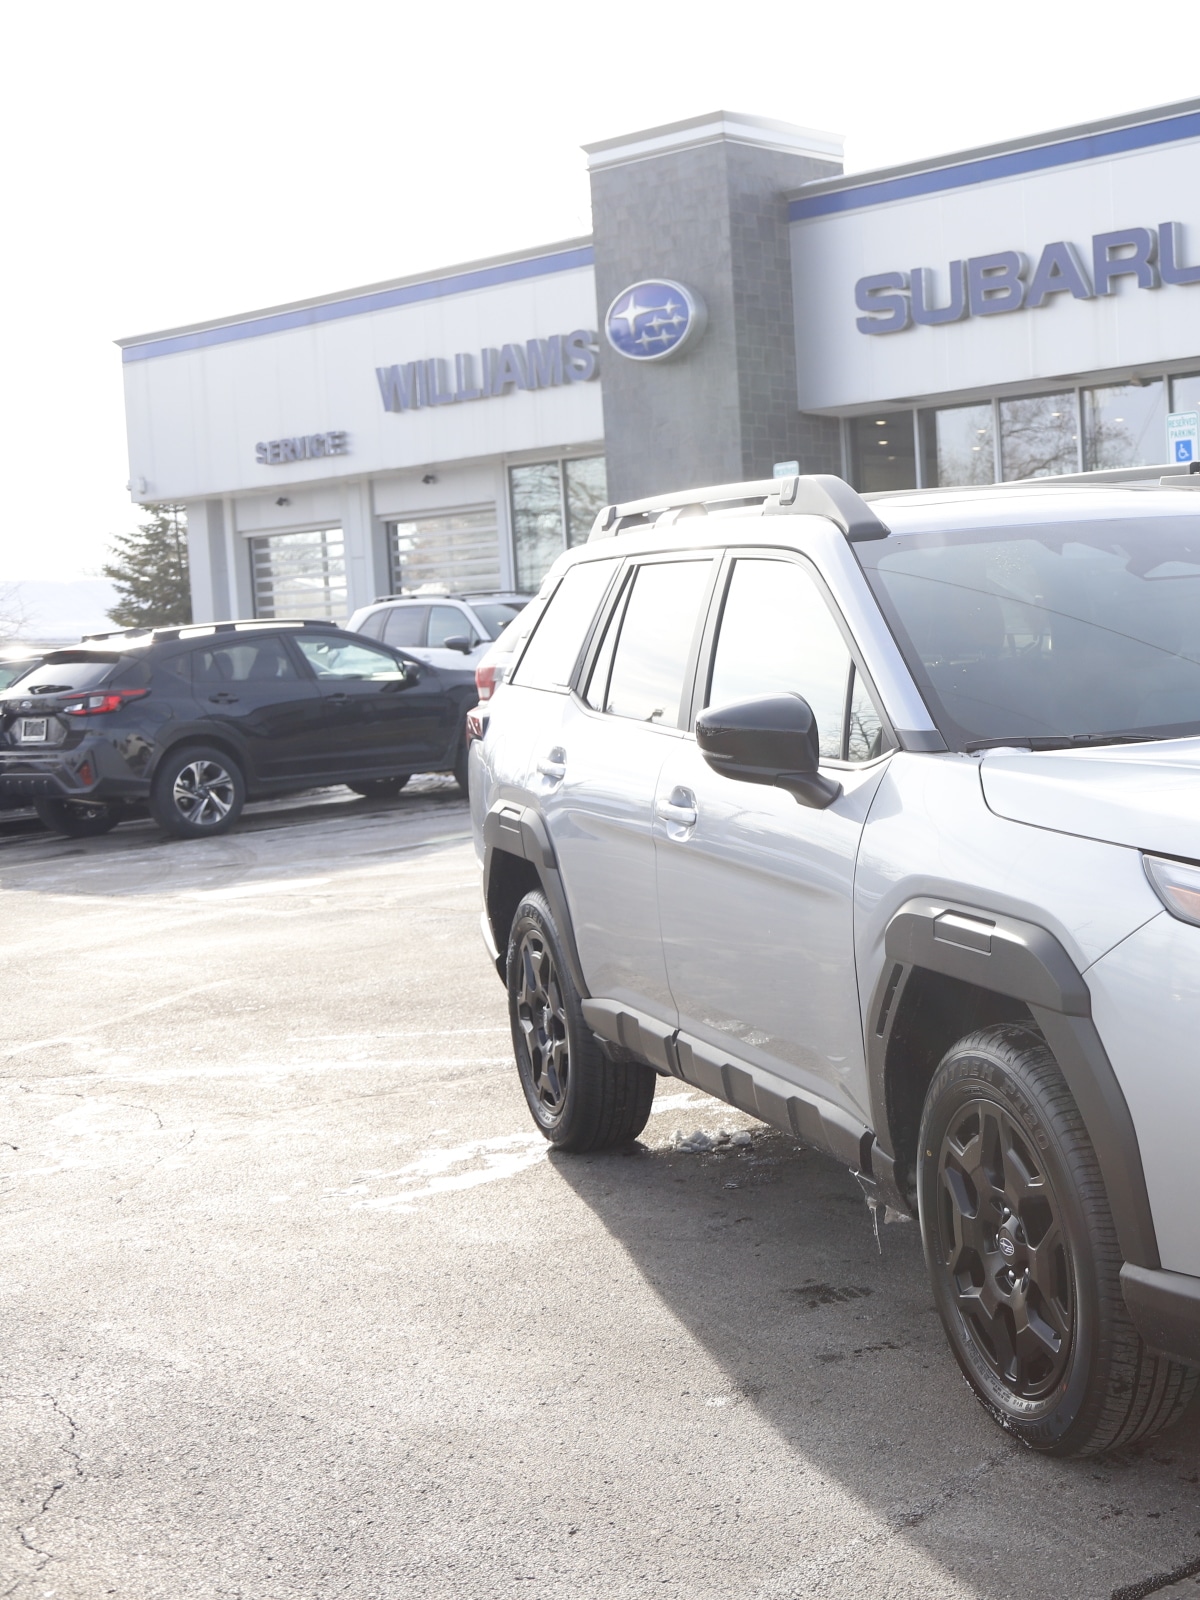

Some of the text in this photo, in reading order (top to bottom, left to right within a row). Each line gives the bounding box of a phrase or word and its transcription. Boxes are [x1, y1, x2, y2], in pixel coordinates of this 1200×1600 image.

[376, 329, 599, 412] WILLIAMS
[1168, 418, 1197, 428] RESERVED
[1170, 429, 1196, 438] PARKING
[255, 431, 350, 465] SERVICE
